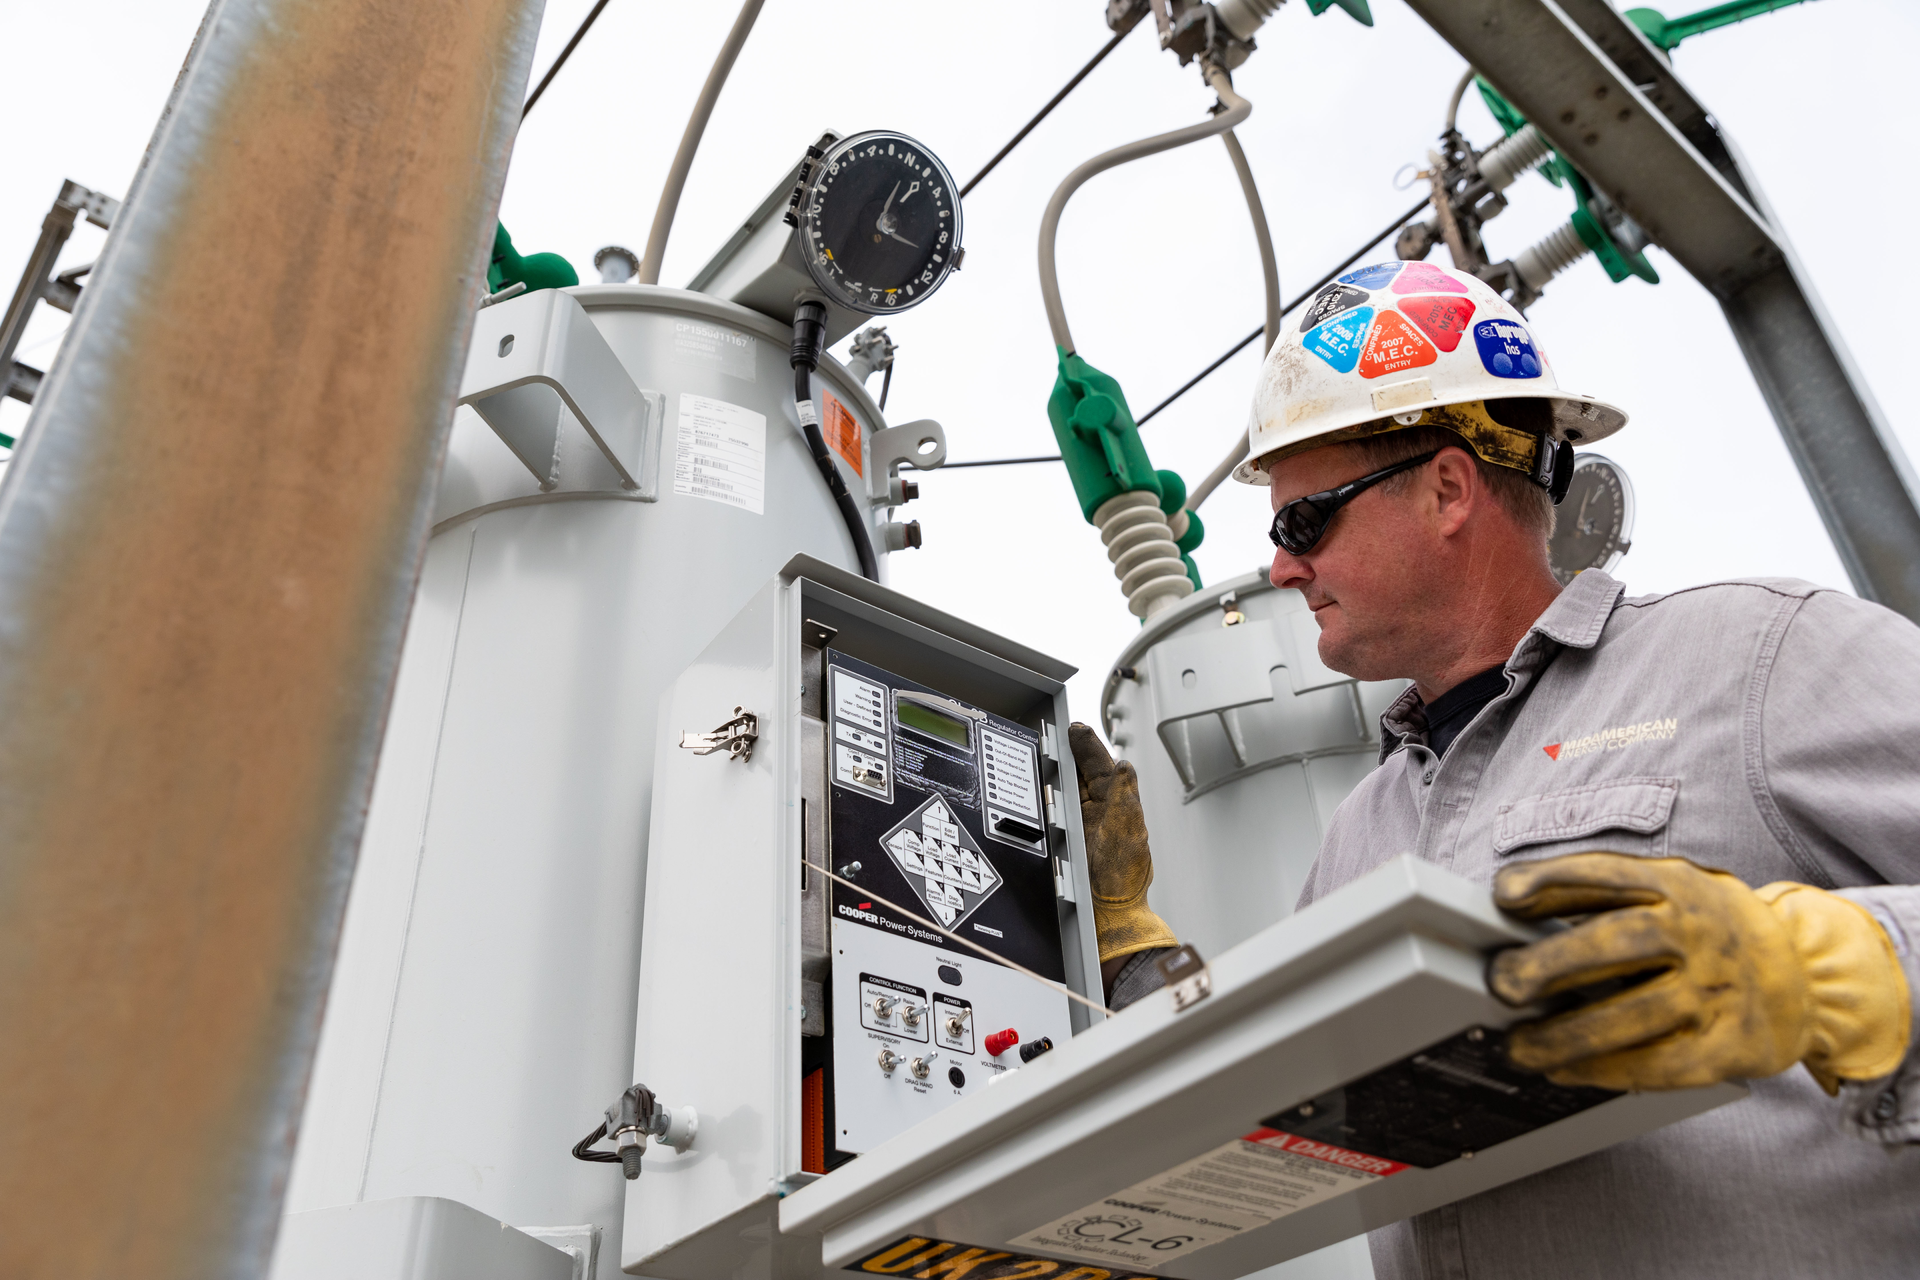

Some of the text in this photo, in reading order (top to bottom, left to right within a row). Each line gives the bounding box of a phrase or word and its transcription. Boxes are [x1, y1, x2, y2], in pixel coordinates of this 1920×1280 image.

[867, 145, 877, 157] 4
[904, 153, 916, 167] N
[933, 187, 942, 198] 4
[940, 231, 948, 244] 8
[921, 270, 933, 284] 12
[870, 292, 878, 303] R
[885, 292, 897, 306] 16
[1427, 304, 1443, 324] 2015
[1438, 306, 1458, 331] MEC
[1321, 311, 1358, 331] CONFINED
[1410, 310, 1439, 338] CONFINED
[1332, 324, 1354, 341] 2008
[1400, 323, 1424, 347] SPACES
[1319, 330, 1349, 356] M.E.C.
[1365, 324, 1382, 361] CONFINED
[1381, 336, 1404, 348] 2007
[1315, 345, 1333, 360] ENTRY
[1372, 345, 1418, 364] M.E.C.
[1504, 342, 1520, 355] has
[1384, 359, 1411, 371] ENTRY
[855, 694, 871, 704] Warning
[840, 707, 861, 718] Diagnostic
[856, 703, 872, 713] Defined
[989, 719, 1039, 744] Regulator Control
[1562, 718, 1677, 752] MIDAMERICAN
[994, 738, 1007, 748] Voltage
[1008, 744, 1019, 753] Limiter
[1558, 730, 1676, 761] ENERGY COMPANY
[996, 768, 1009, 776] Voltage
[1010, 772, 1022, 780] Limiter
[998, 786, 1024, 799] Reverse Power
[1013, 782, 1028, 792] Blocked
[999, 795, 1031, 811] Voltage Reduction
[922, 822, 940, 832] Function
[887, 841, 902, 851] Escape
[906, 844, 921, 852] Voltage
[926, 850, 940, 859] Voltage
[944, 856, 959, 865] Current
[906, 862, 923, 872] Settings
[962, 862, 978, 870] Position
[926, 868, 943, 878] Features
[944, 875, 962, 884] Counters
[963, 880, 980, 890] Metering
[928, 893, 942, 901] Events
[838, 904, 943, 943] COOPER Power Systems
[936, 956, 950, 965] Neutral
[869, 976, 917, 994] CONTROL FUNCTION
[943, 997, 960, 1006] POWER
[874, 1020, 890, 1028] Manual
[868, 1033, 901, 1044] SUPERVISORY
[946, 1038, 963, 1046] External
[981, 1060, 1007, 1071] VOLTMETER
[905, 1078, 919, 1086] DRAG
[1287, 1140, 1392, 1172] DANGER
[1104, 1198, 1243, 1230] COOPER Power Systems
[1073, 1219, 1194, 1250] CL-6
